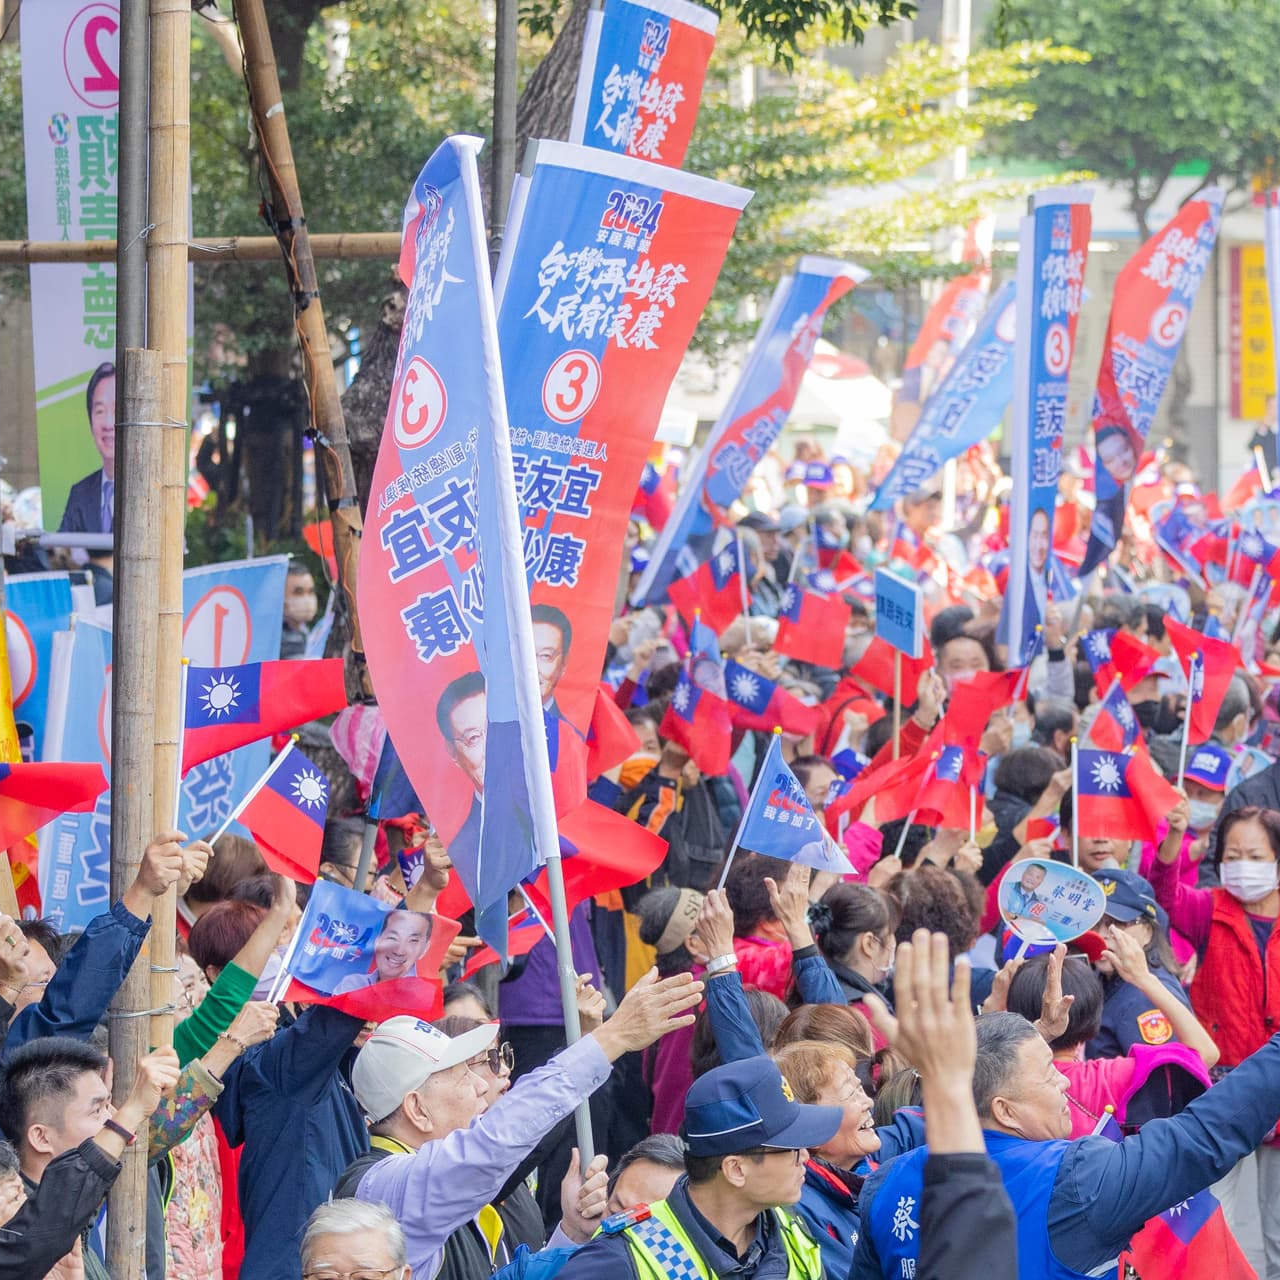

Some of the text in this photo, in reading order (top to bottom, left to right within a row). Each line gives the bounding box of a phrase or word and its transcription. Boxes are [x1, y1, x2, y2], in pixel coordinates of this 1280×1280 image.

[601, 190, 664, 240] 2024
[595, 229, 652, 254] 安居樂業
[538, 241, 689, 308] 台灣再出發
[522, 288, 665, 351] 人民有侯康
[1050, 331, 1065, 367] 3
[552, 359, 591, 415] 3
[762, 804, 816, 830] 我參加了
